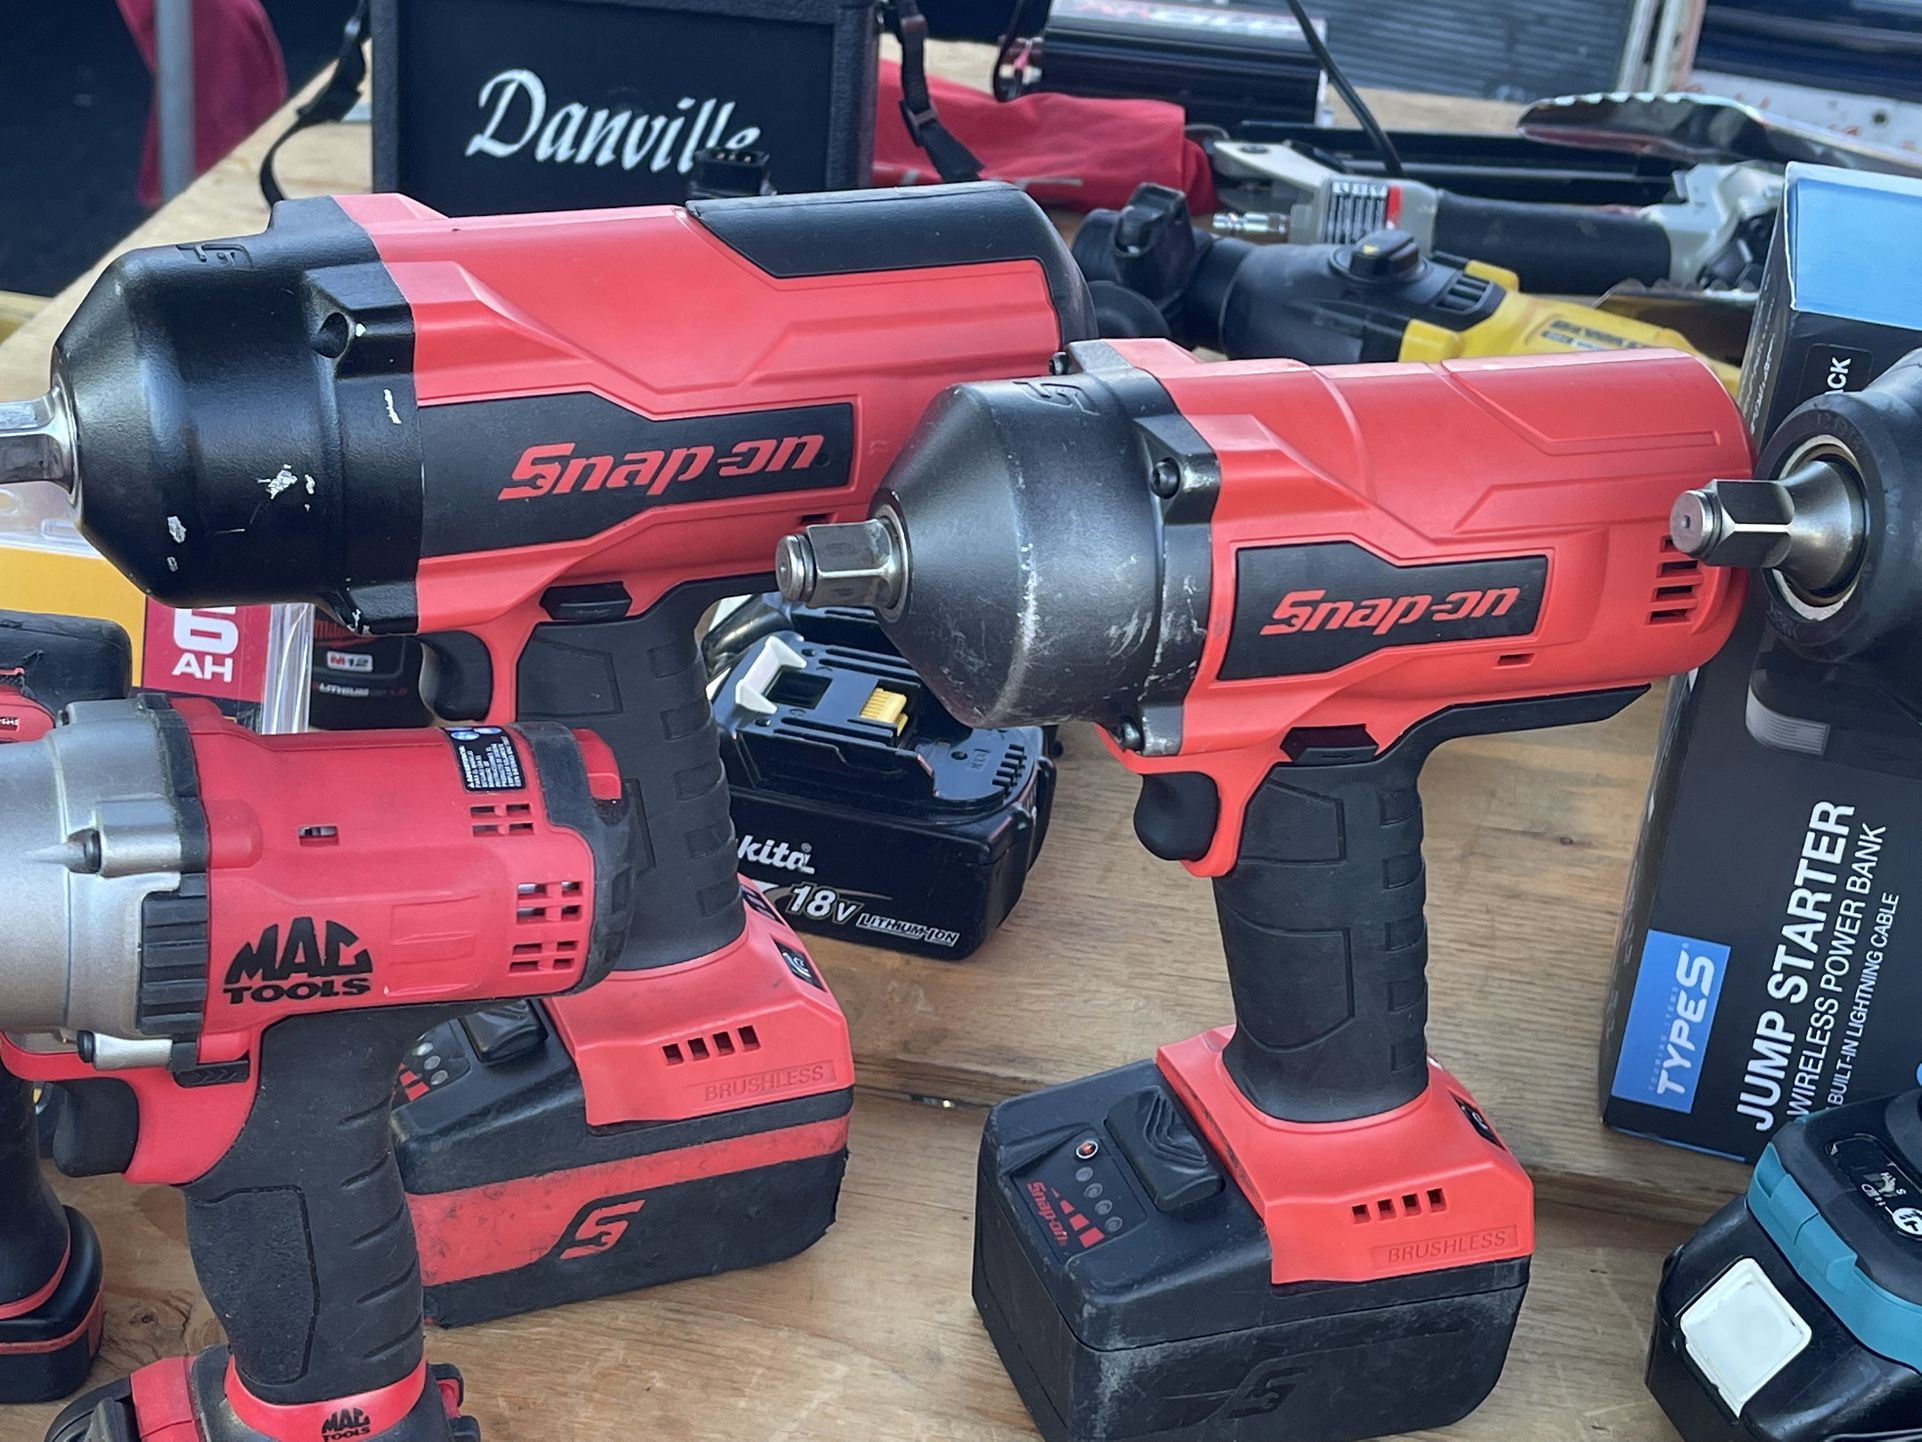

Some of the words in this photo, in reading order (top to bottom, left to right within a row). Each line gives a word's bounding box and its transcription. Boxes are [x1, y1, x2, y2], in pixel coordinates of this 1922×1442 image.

[498, 433, 825, 500] Snap-on
[173, 606, 239, 654] 6
[1259, 587, 1520, 635] Snap-on
[172, 652, 233, 682] AH
[737, 834, 815, 874] kita
[224, 917, 373, 984] MAC
[1736, 1010, 1795, 1132] JUMP
[1767, 800, 1855, 1004] STARTER
[1786, 996, 1839, 1120] WIRELESS
[1820, 898, 1866, 993] POWER
[1846, 822, 1887, 895] BANK
[223, 978, 371, 1004] TOOLS
[1827, 1038, 1858, 1106] BUILT-IN
[1846, 950, 1883, 1039] LIGHTNING
[1870, 892, 1900, 949] CABLE
[705, 1065, 824, 1101] BRUSHLESS
[1388, 1230, 1506, 1263] BRUSHLESS
[322, 1407, 371, 1434] MAC
[322, 1426, 371, 1442] TOOLS
